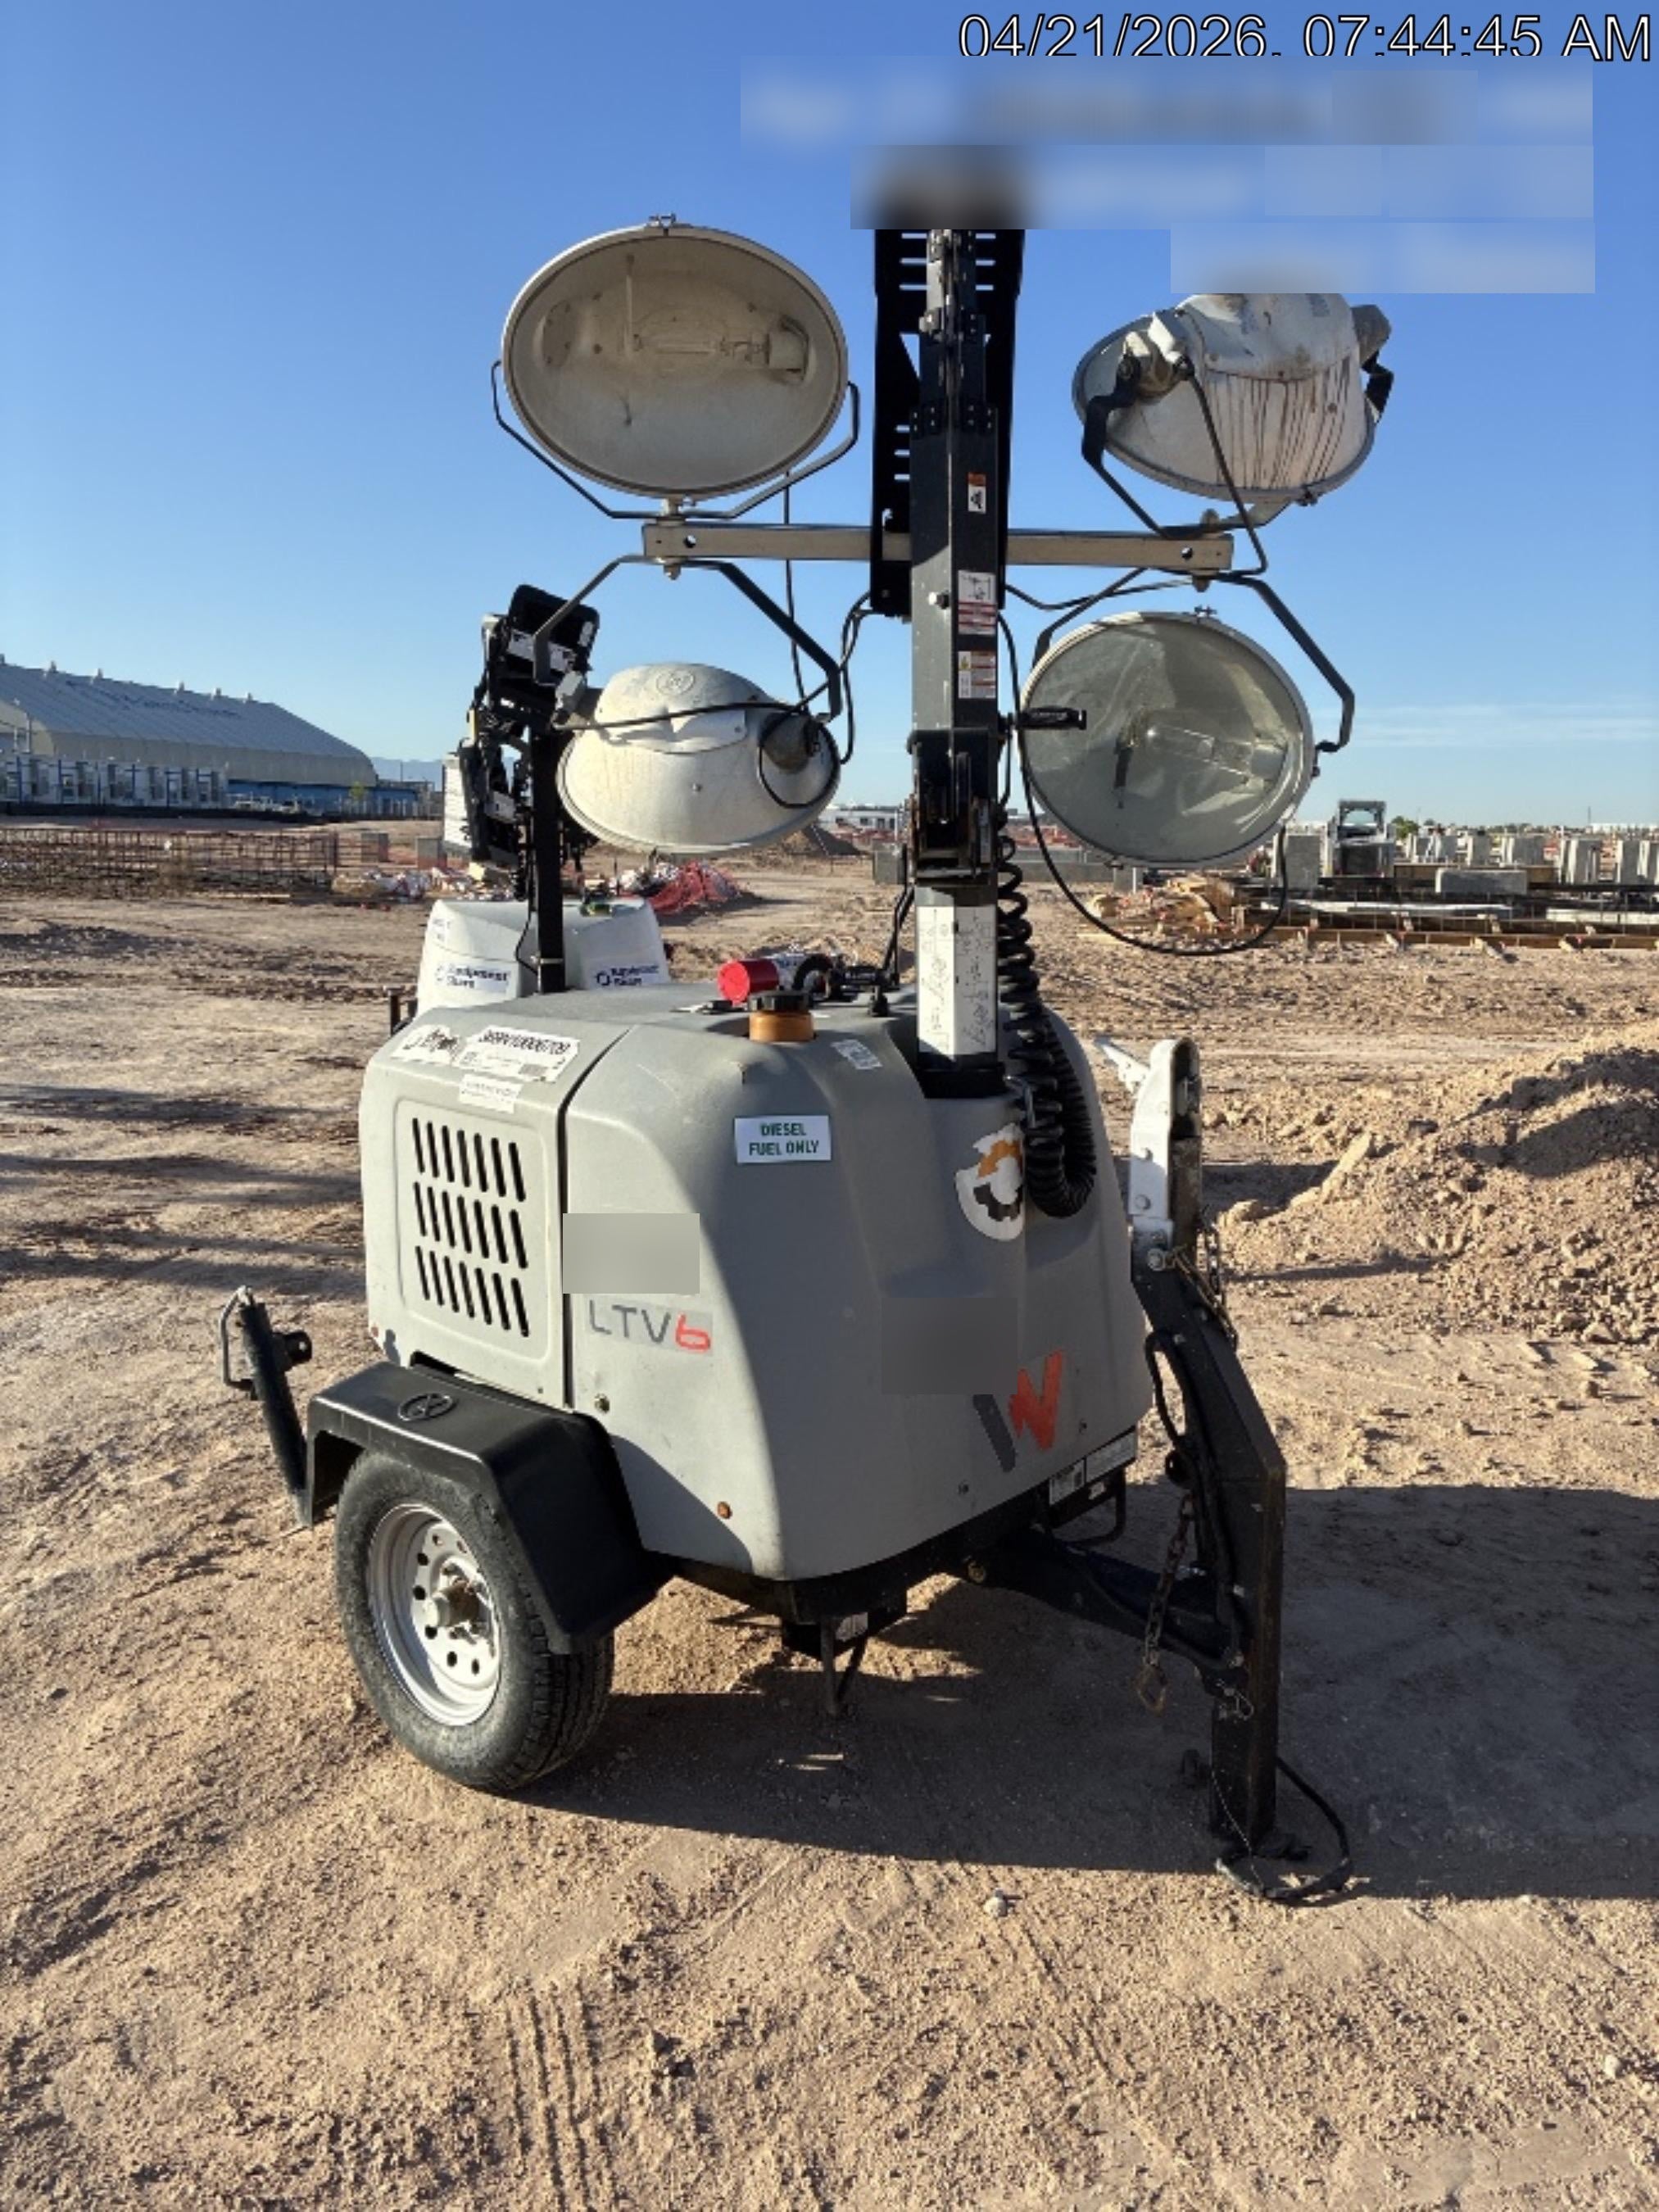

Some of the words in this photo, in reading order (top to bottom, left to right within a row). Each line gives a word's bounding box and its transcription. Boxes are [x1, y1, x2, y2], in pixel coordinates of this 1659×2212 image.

[760, 1122, 807, 1136] DIESEL
[749, 1142, 782, 1156] FUEL
[786, 1140, 819, 1154] ONLY
[588, 1299, 711, 1353] LTV6
